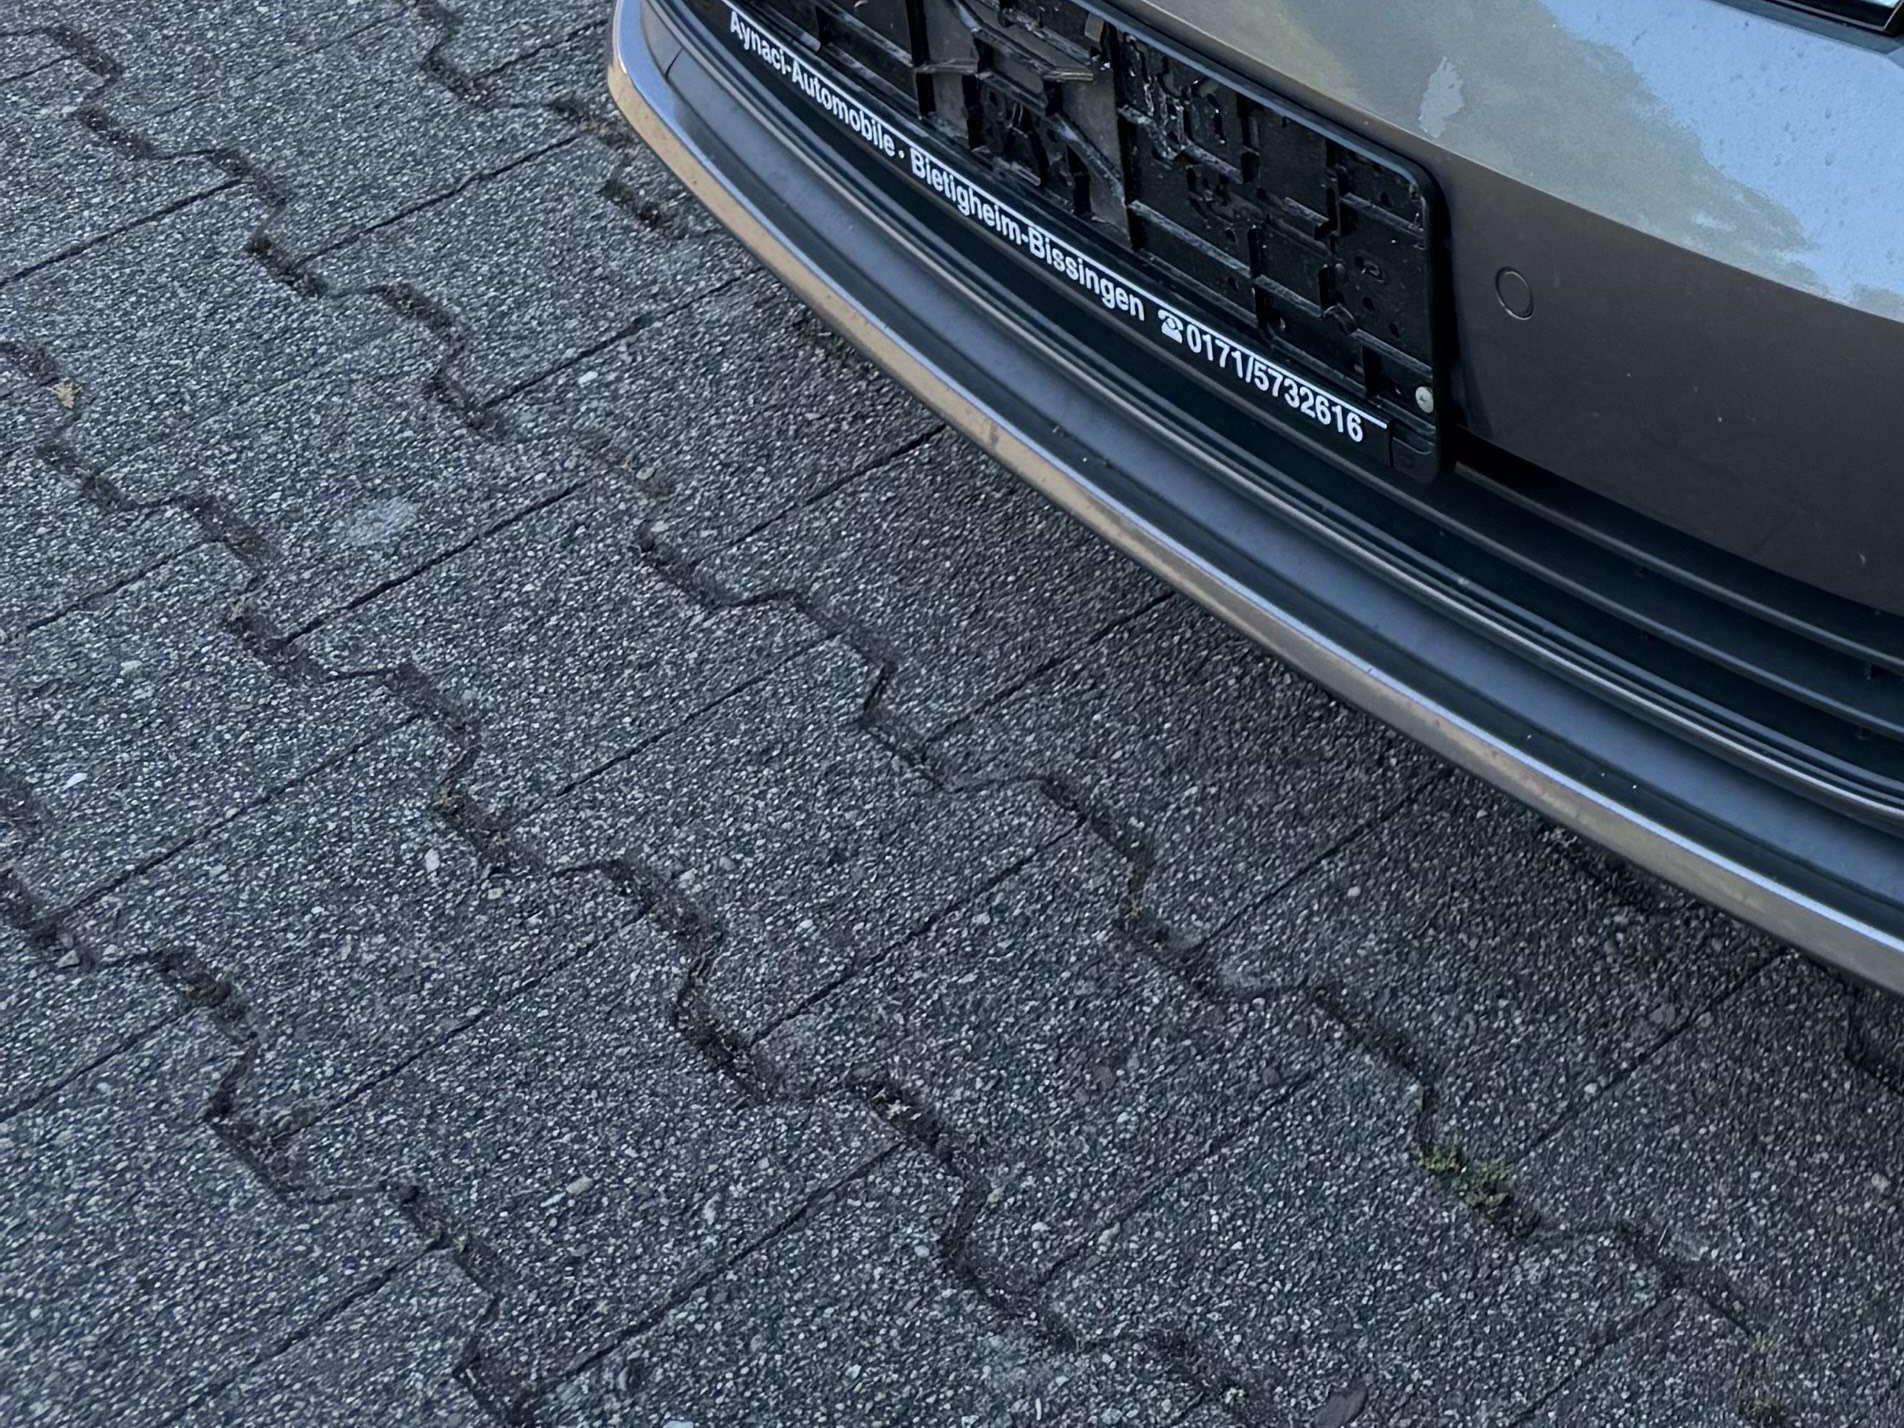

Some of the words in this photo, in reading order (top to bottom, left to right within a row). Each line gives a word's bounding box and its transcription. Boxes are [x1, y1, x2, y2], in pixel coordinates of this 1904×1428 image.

[730, 10, 896, 158] Aynaci-Automobile
[910, 147, 1145, 321] Bietigheim-Bissingen
[1186, 326, 1364, 442] 0171/5732616
